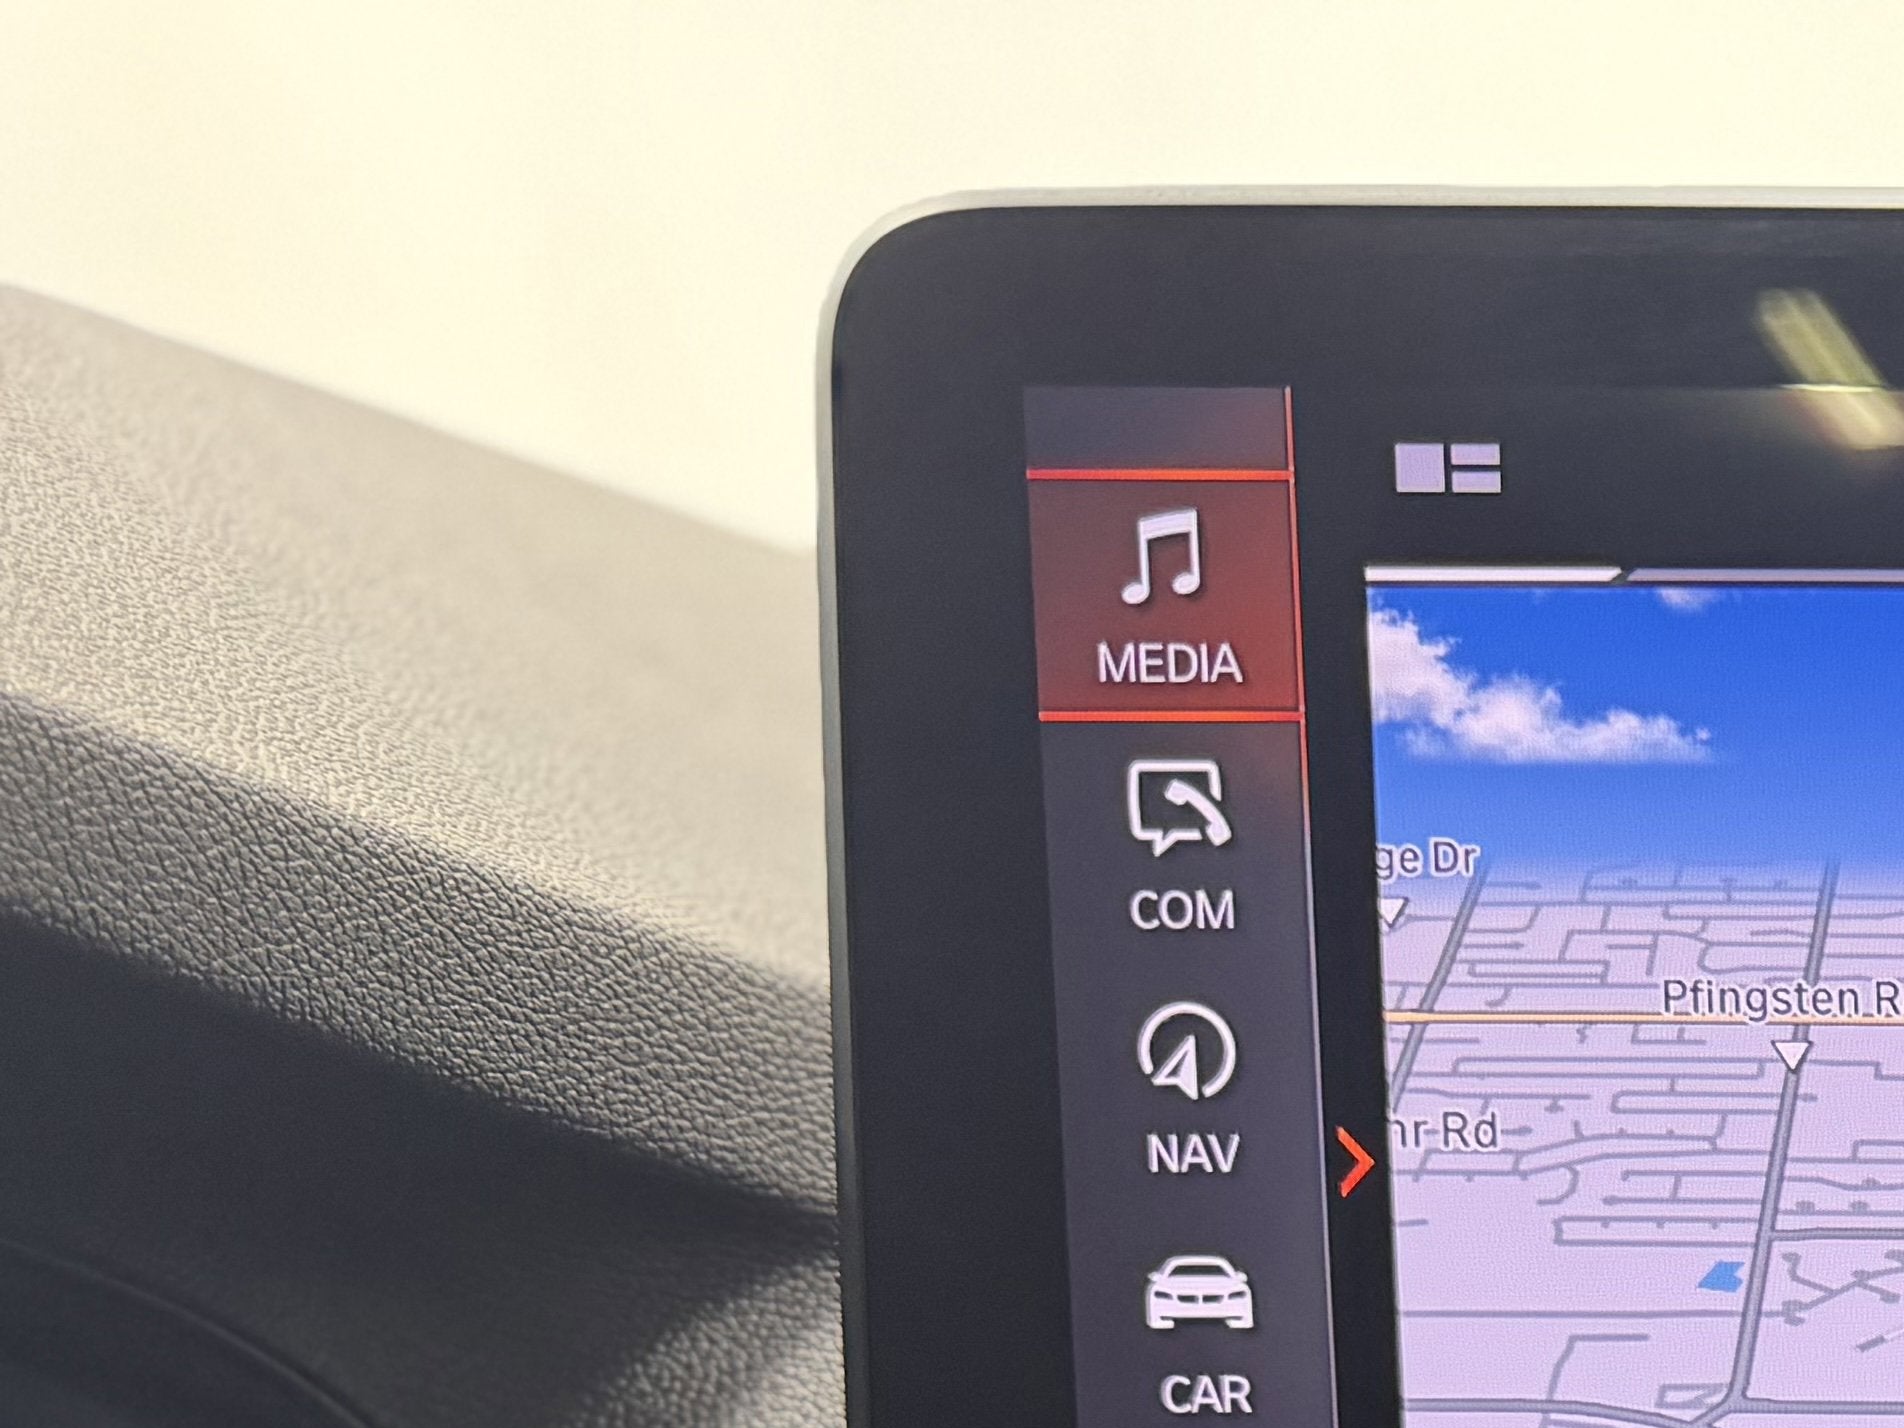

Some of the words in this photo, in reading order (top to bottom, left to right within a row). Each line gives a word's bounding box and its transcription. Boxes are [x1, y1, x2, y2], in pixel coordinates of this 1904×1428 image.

[1097, 642, 1244, 684] MEDIA
[1433, 841, 1477, 874] Dr
[1129, 890, 1236, 930] COM
[1662, 979, 1858, 1022] Pfingsten
[1442, 1111, 1497, 1148] Rd
[1147, 1133, 1239, 1173] NAV
[1159, 1374, 1253, 1414] CAR
